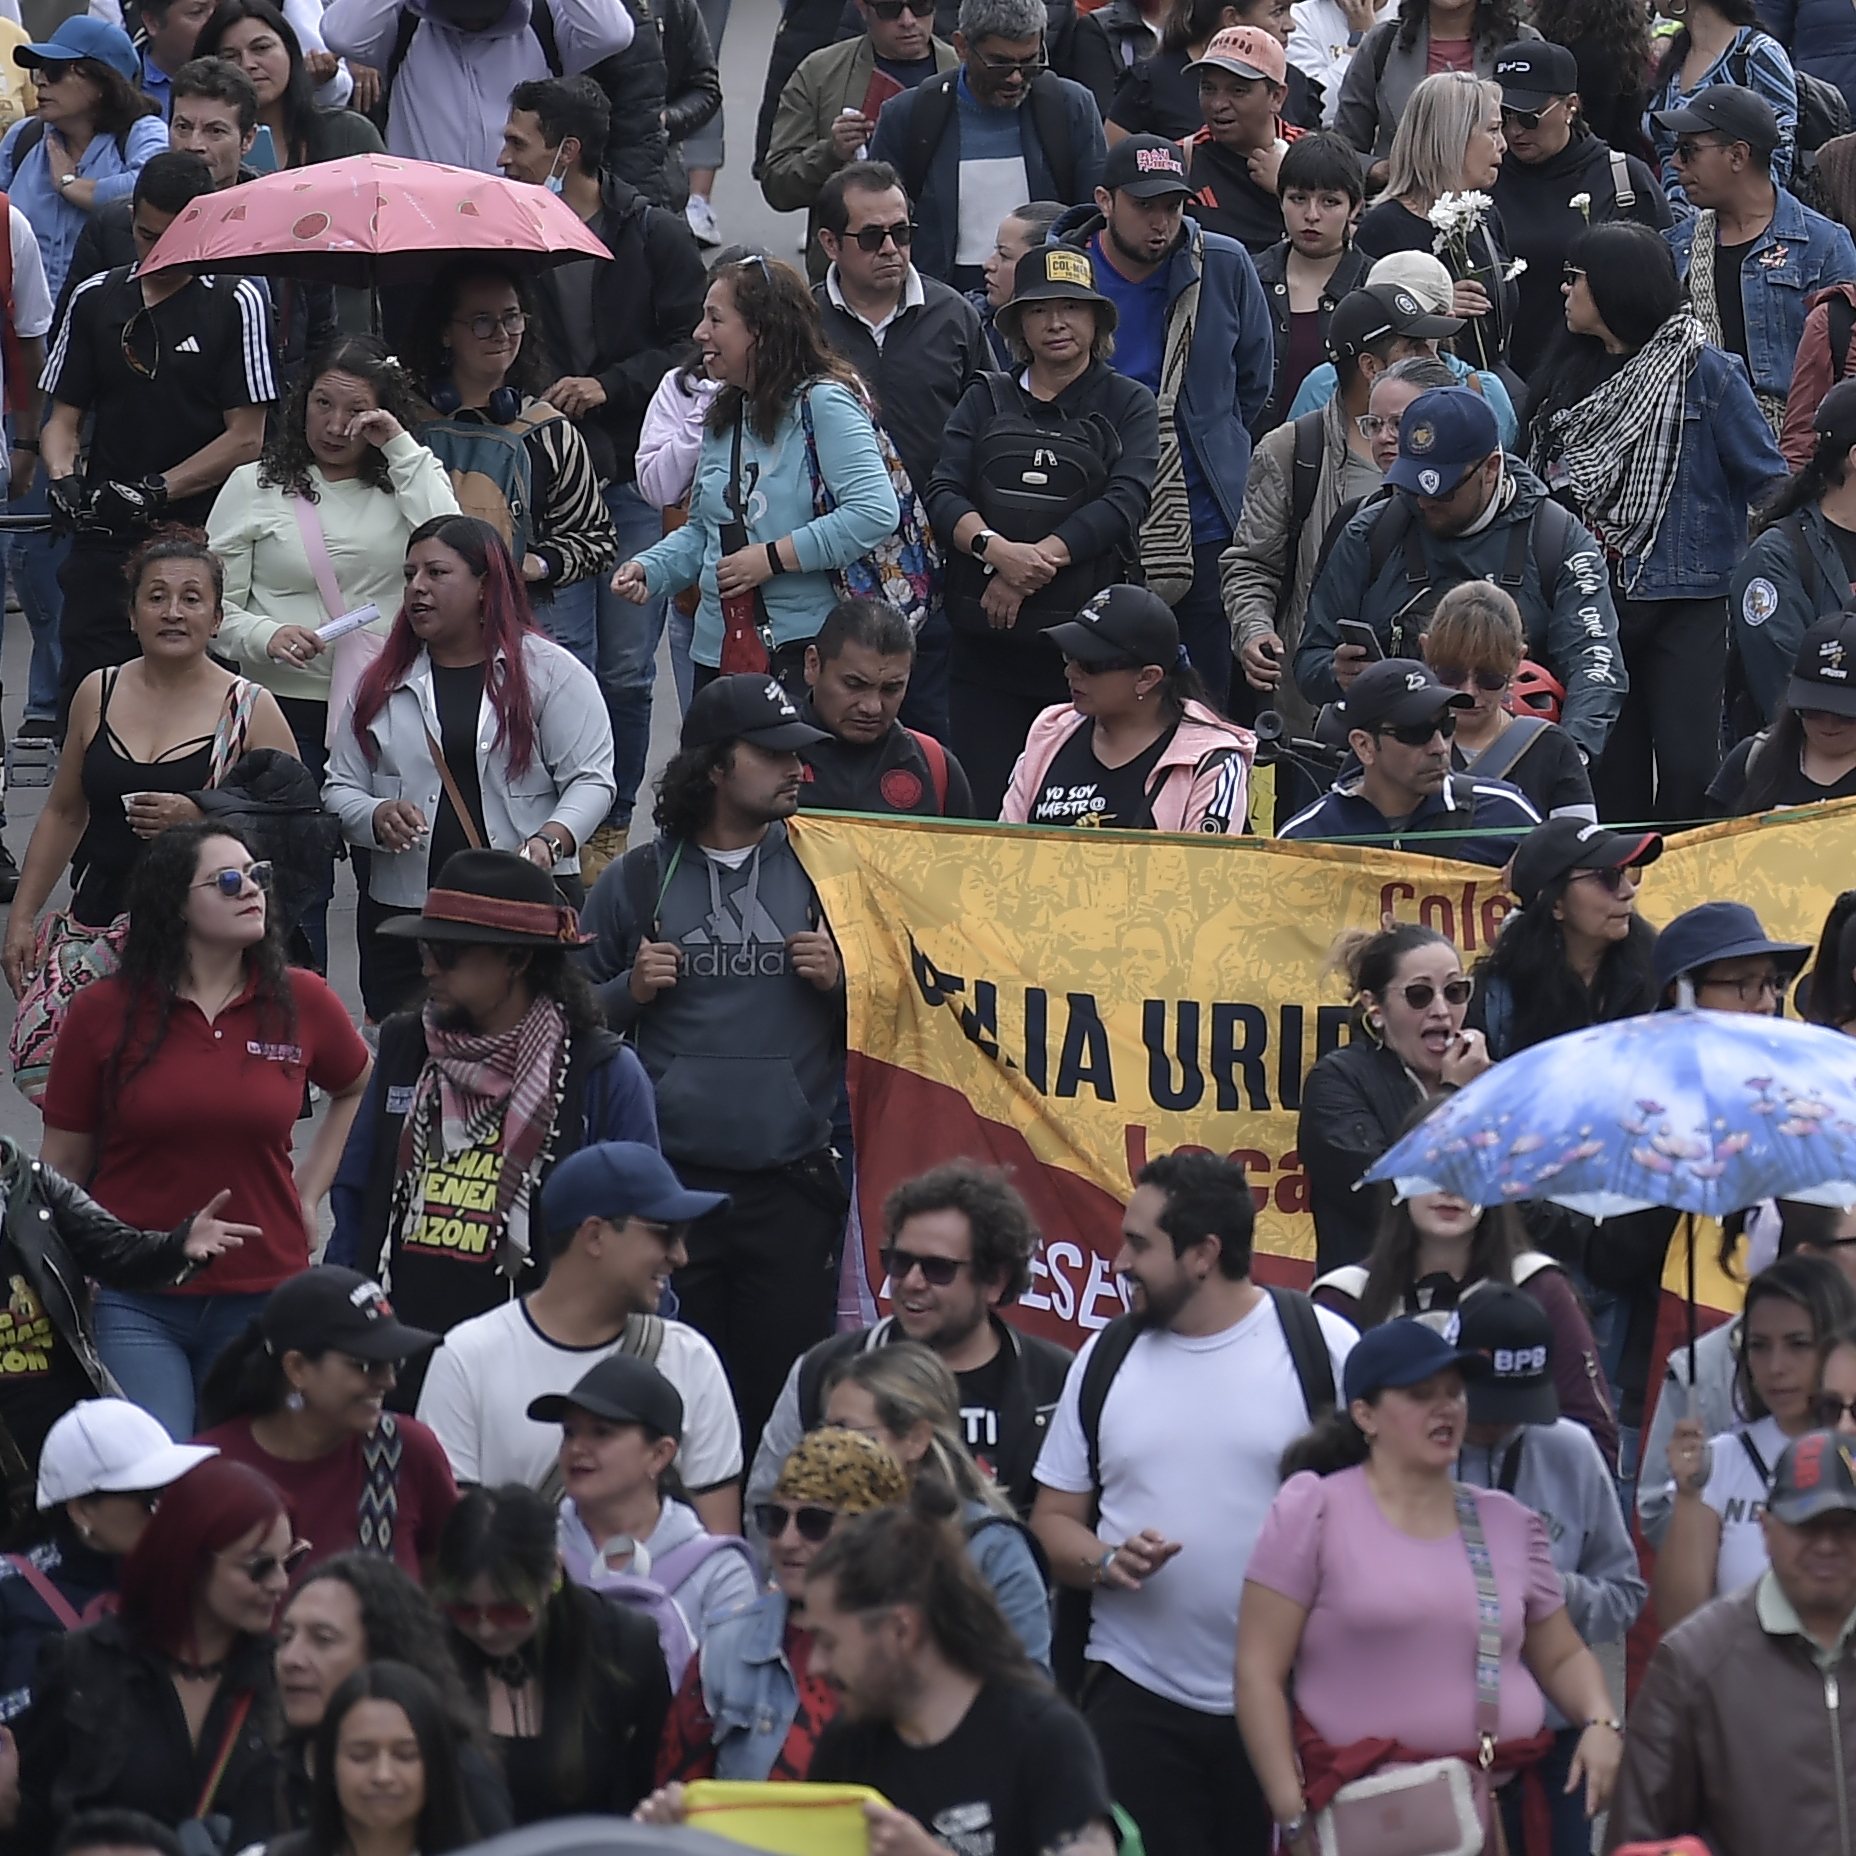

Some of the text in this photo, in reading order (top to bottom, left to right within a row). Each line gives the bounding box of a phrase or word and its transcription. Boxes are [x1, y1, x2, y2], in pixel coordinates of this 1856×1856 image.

[1045, 782, 1099, 801] YO SOY
[1381, 880, 1514, 954] Cole
[680, 940, 789, 971] adida
[402, 1208, 488, 1254] AZÓN
